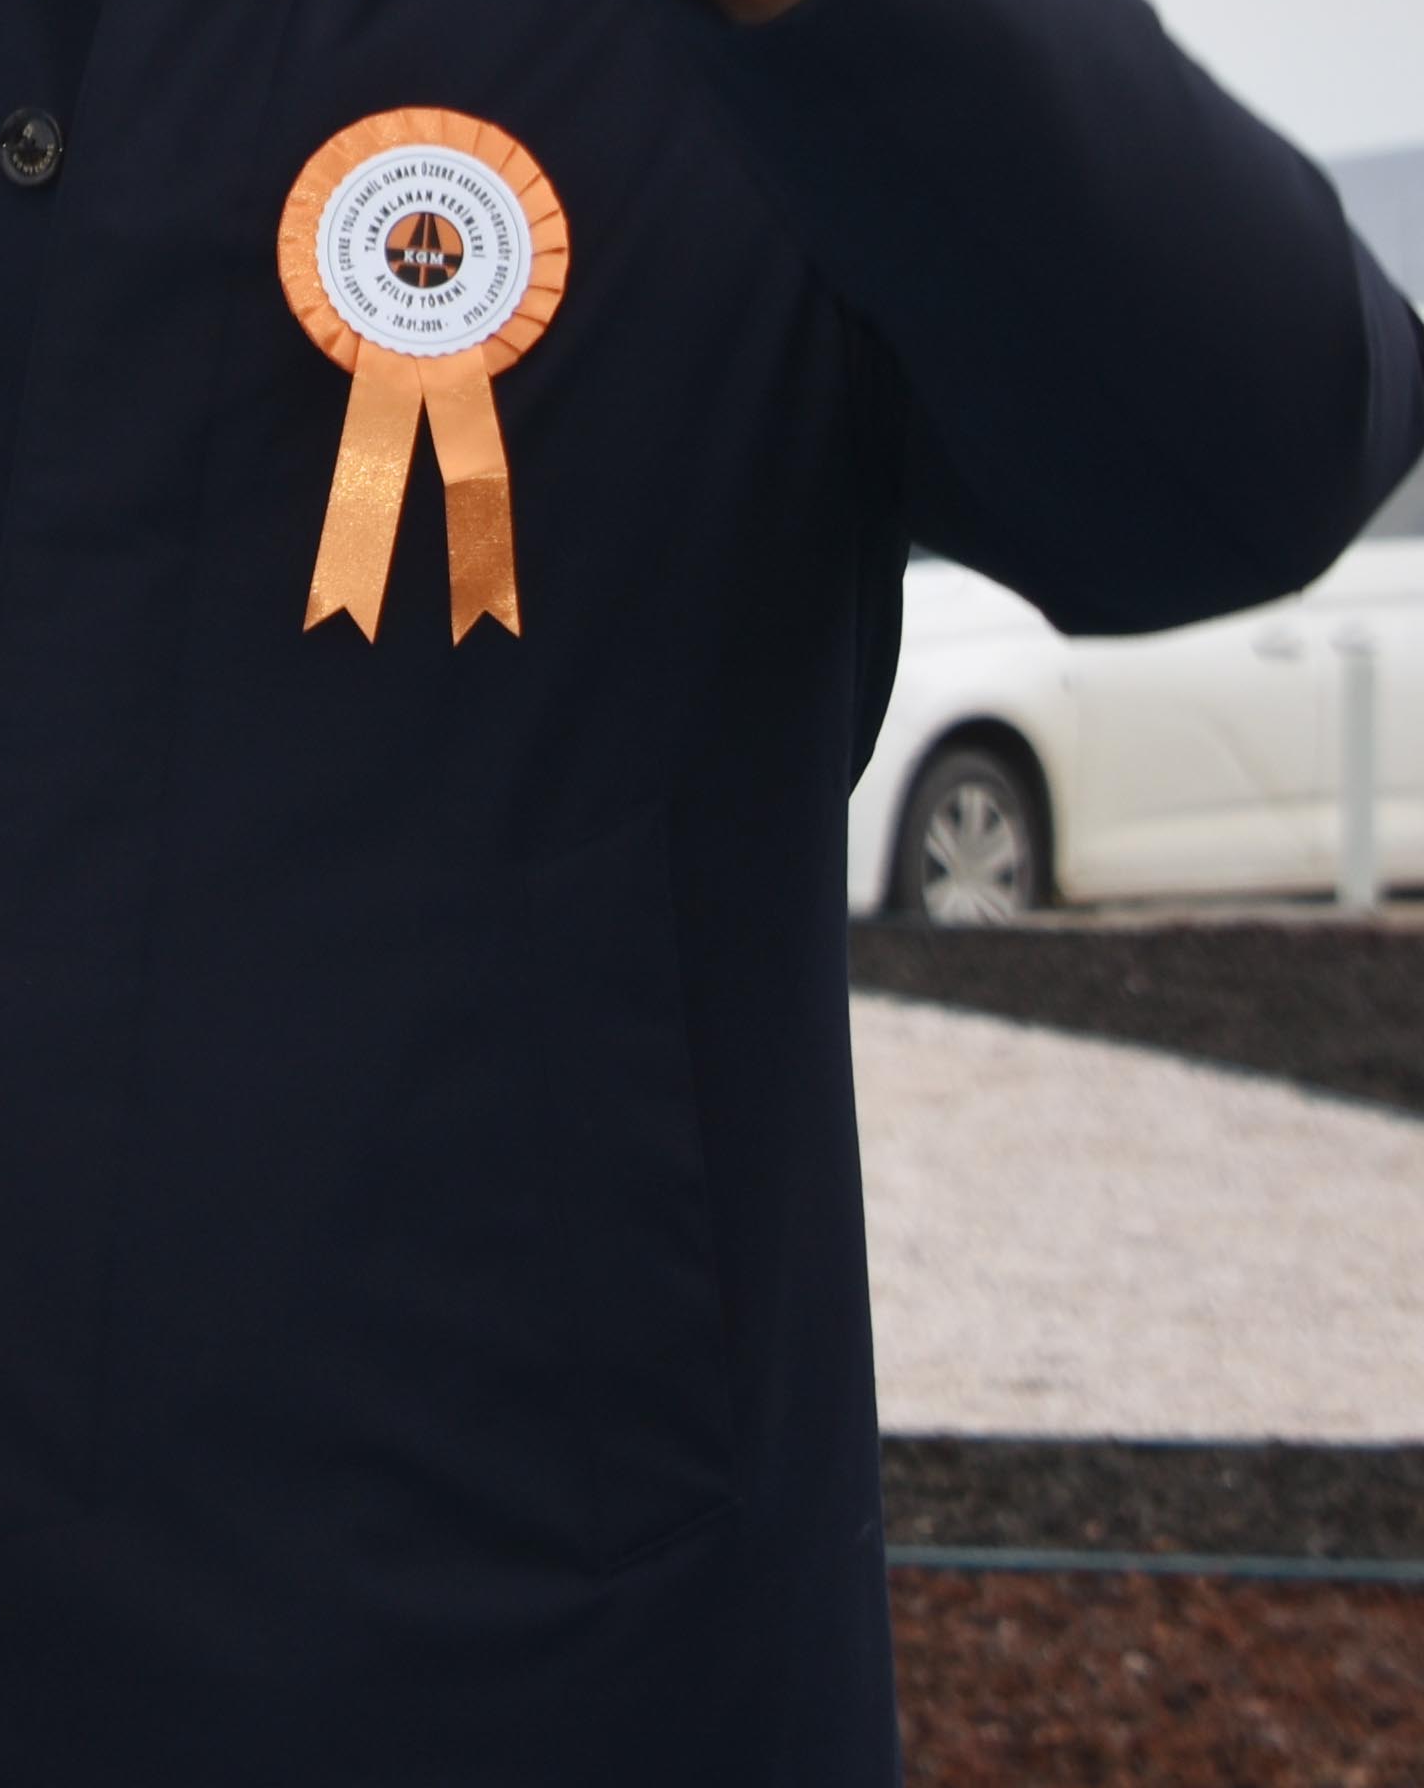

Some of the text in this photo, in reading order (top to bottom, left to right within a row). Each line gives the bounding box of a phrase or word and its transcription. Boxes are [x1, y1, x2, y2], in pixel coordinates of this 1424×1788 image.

[365, 189, 486, 258] TAMAMLANAN KESİMLERİ
[382, 164, 417, 185] OLMAK
[421, 161, 455, 181] ÜZERE
[463, 301, 488, 326] YOLU
[404, 249, 444, 265] KGM
[375, 274, 467, 308] AÇILIŞ TÖRENİ
